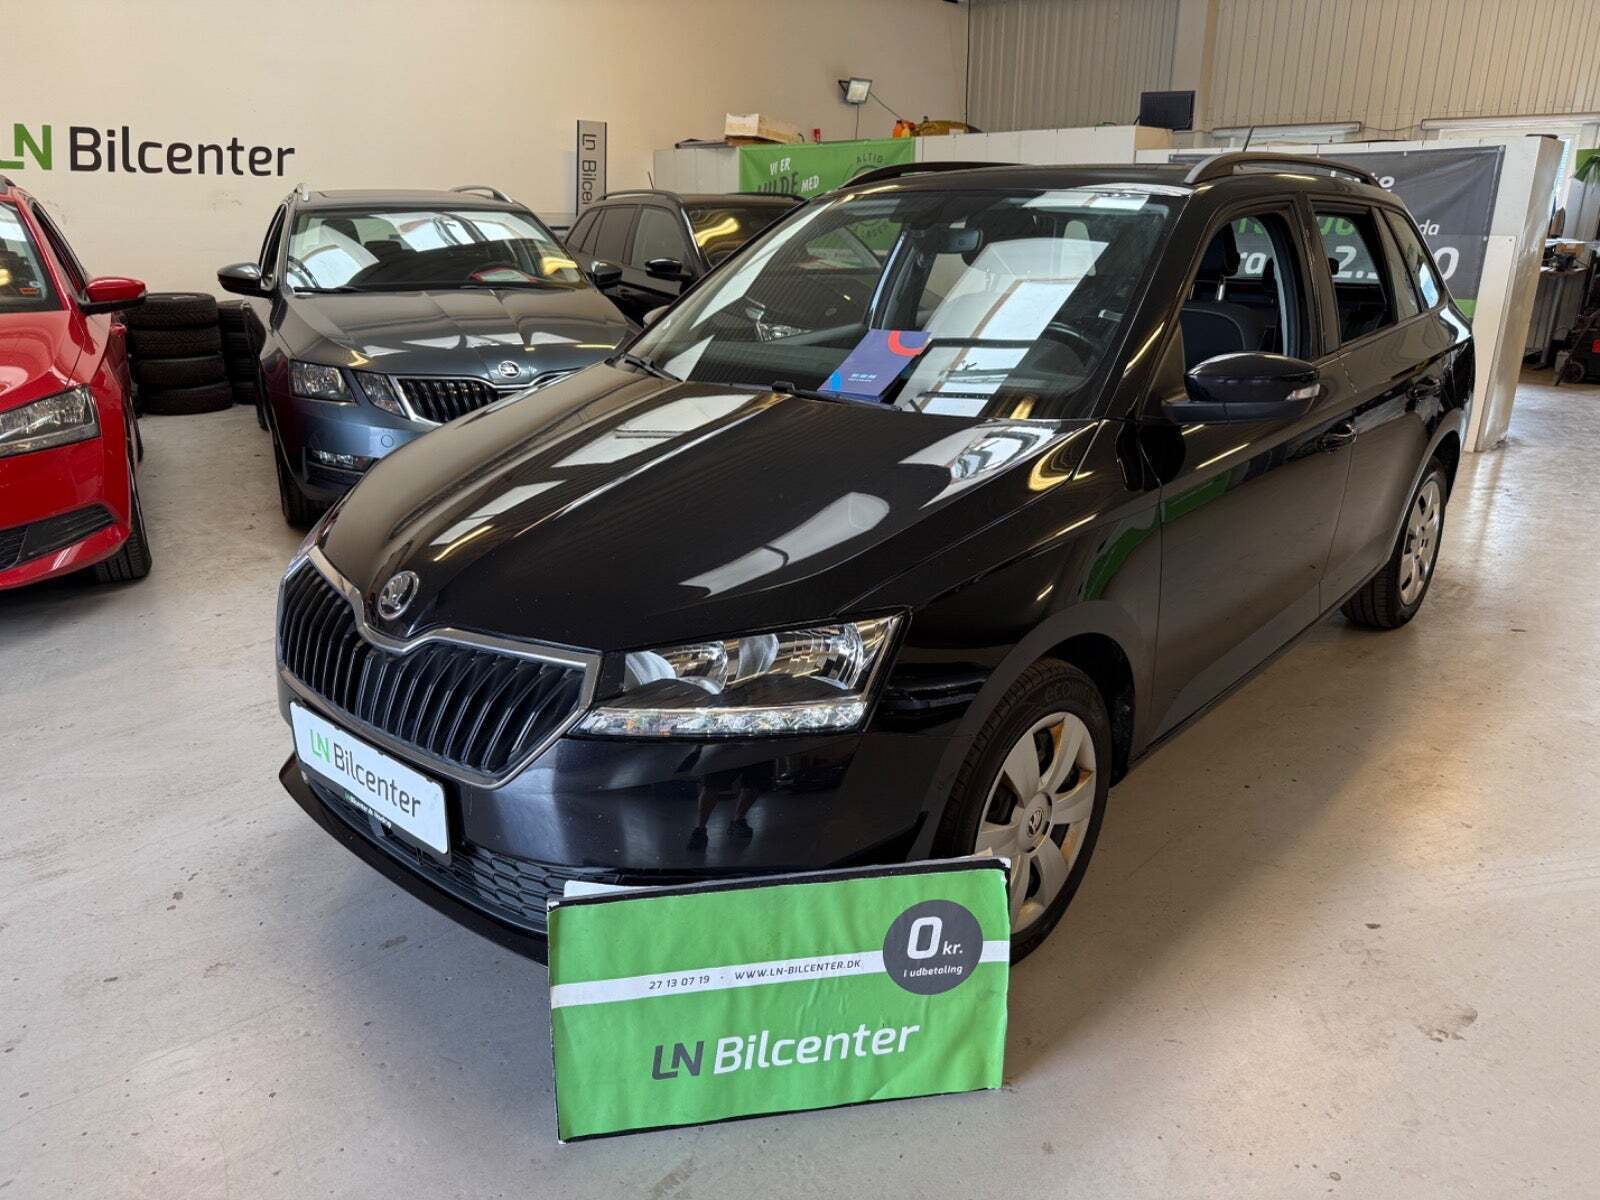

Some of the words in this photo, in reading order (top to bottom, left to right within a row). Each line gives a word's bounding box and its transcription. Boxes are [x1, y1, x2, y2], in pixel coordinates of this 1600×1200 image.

[69, 125, 296, 177] Bilcenter
[780, 157, 791, 172] ER
[801, 175, 819, 192] MED
[333, 742, 421, 818] Bilcenter
[907, 916, 943, 960] 0
[942, 940, 964, 955] kr.
[649, 980, 662, 990] 27
[667, 978, 678, 988] 13
[681, 977, 695, 987] 07
[700, 975, 710, 985] 19
[735, 959, 862, 980] WWW.LN-BILCENTER.DK
[910, 965, 963, 977] udbetaling
[652, 1041, 704, 1080] LN
[714, 1024, 920, 1074] Bilcenter
